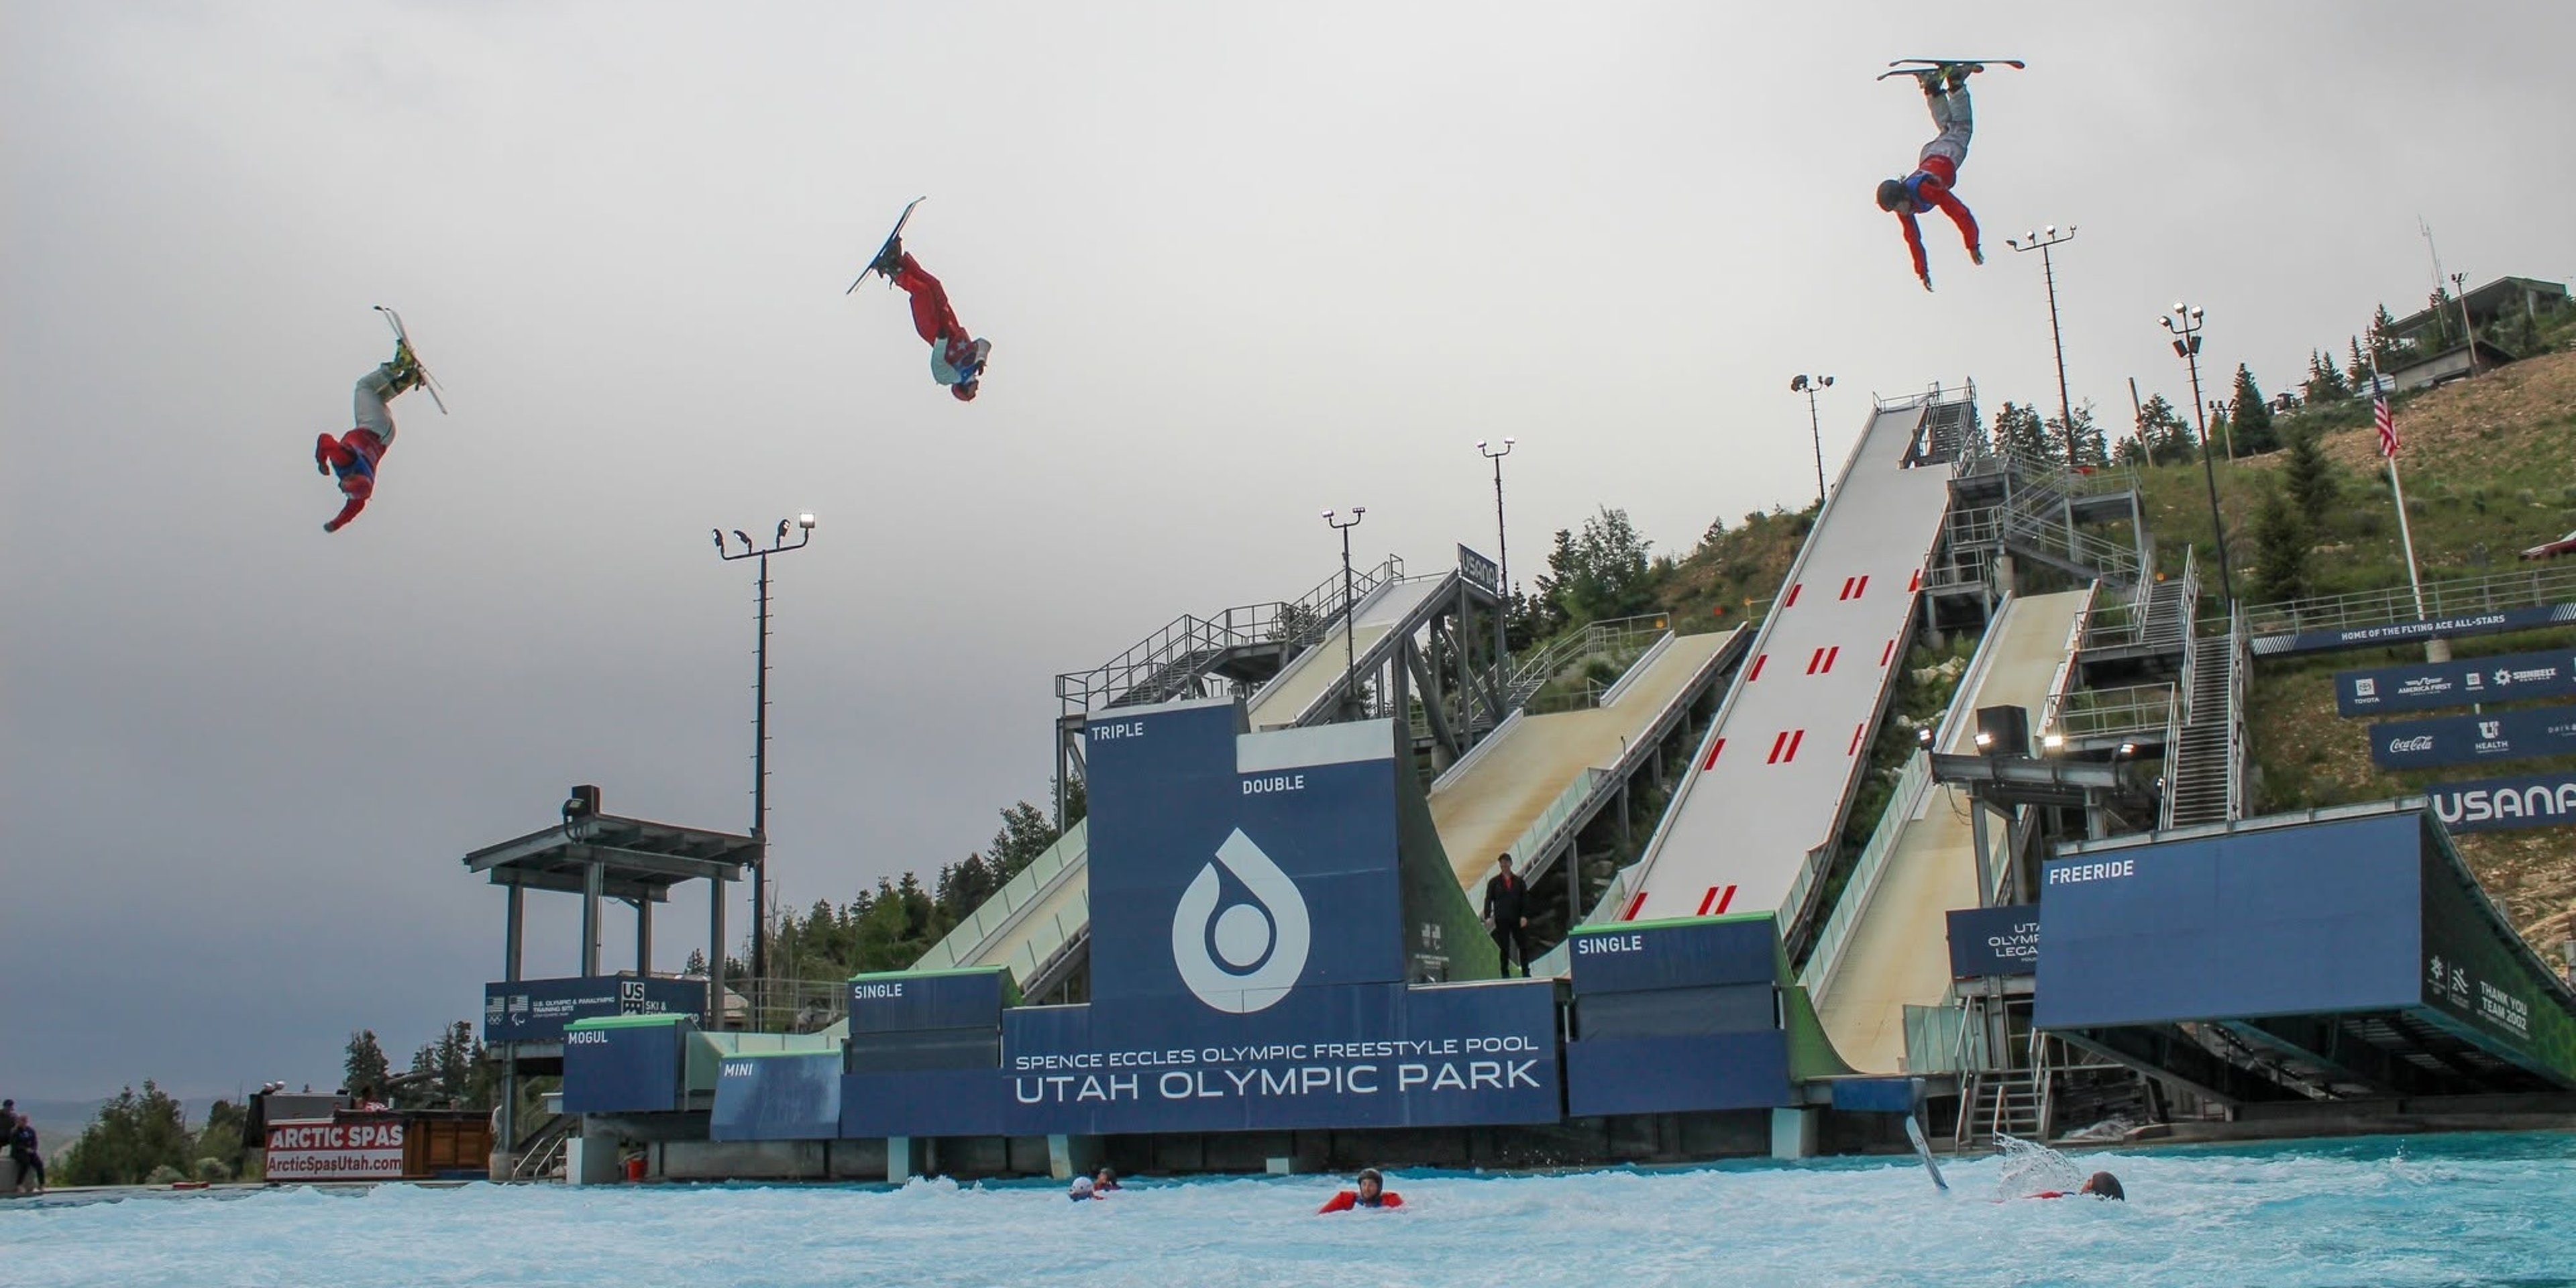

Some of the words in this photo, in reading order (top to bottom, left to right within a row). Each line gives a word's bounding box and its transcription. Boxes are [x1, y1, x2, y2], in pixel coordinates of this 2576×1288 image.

[1462, 551, 1496, 588] USANA
[2341, 631, 2367, 641] HOME
[2368, 629, 2380, 637] OF
[2383, 627, 2400, 636] THE
[2402, 623, 2433, 634] FLYING
[2435, 621, 2453, 631] ACE
[2455, 614, 2506, 627] ALL-STARS
[2398, 685, 2430, 694] AMERICA
[2430, 683, 2453, 691] FIRST
[1091, 722, 1144, 741] TRIPLE
[2475, 741, 2509, 750] HEALTH
[1243, 775, 1305, 795] DOUBLE
[2433, 783, 2576, 823] USANA
[2049, 860, 2134, 885] FREERIDE
[1578, 935, 1642, 955] SINGLE
[623, 983, 643, 999] US
[855, 983, 902, 1000] SINGLE
[2480, 981, 2509, 1007] THANK
[2510, 997, 2528, 1016] YOU
[645, 1001, 659, 1010] SKI
[661, 1002, 666, 1011] &
[2482, 996, 2506, 1019] TEAM
[2507, 1009, 2527, 1031] 2002
[568, 1030, 608, 1044] MOGUL
[1016, 1053, 1103, 1070] SPENCE
[1110, 1049, 1196, 1067] ECCLES
[1202, 1044, 1306, 1063] OLYMPIC
[1314, 1039, 1458, 1058] FREESTYLE
[1466, 1036, 1538, 1053] POOL
[724, 1063, 753, 1077] MINI
[1016, 1073, 1138, 1104] UTAH
[1159, 1065, 1378, 1099] OLYMPIC
[1399, 1059, 1540, 1092] PARK
[270, 1126, 344, 1148] ARCTIC
[348, 1124, 402, 1147] SPAS
[269, 1155, 402, 1174] ArcticSpasUtah.com
